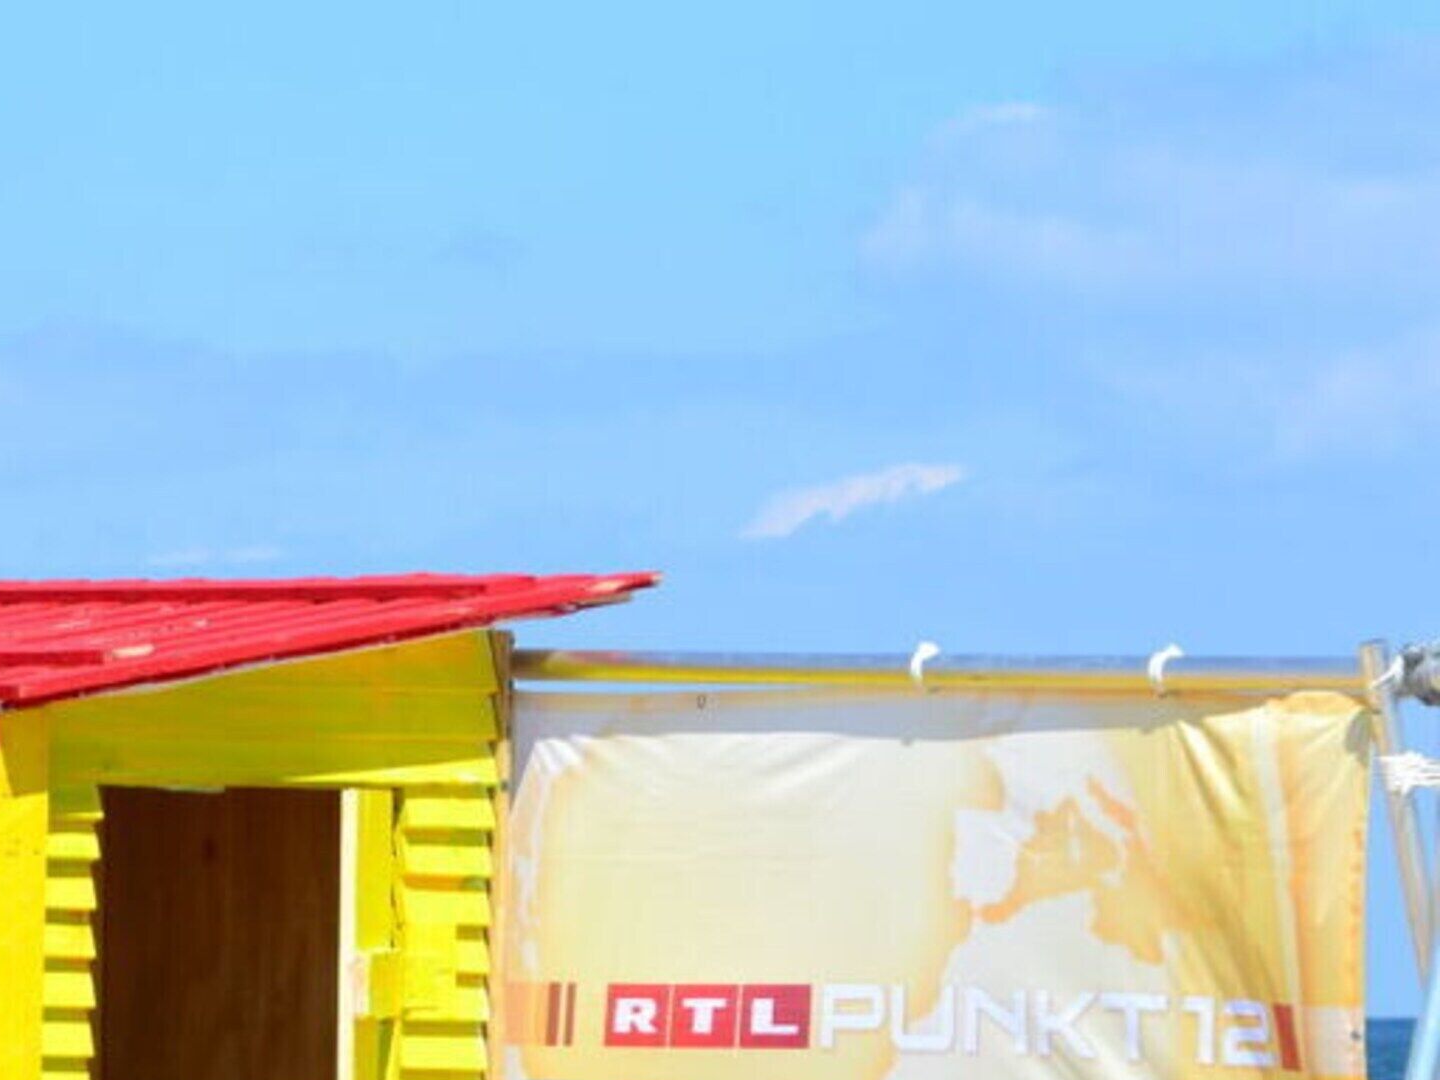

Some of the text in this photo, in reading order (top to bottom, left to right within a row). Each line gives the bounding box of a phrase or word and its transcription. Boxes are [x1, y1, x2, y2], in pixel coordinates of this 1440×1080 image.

[611, 984, 1277, 1068] RTL PUNKT 12
